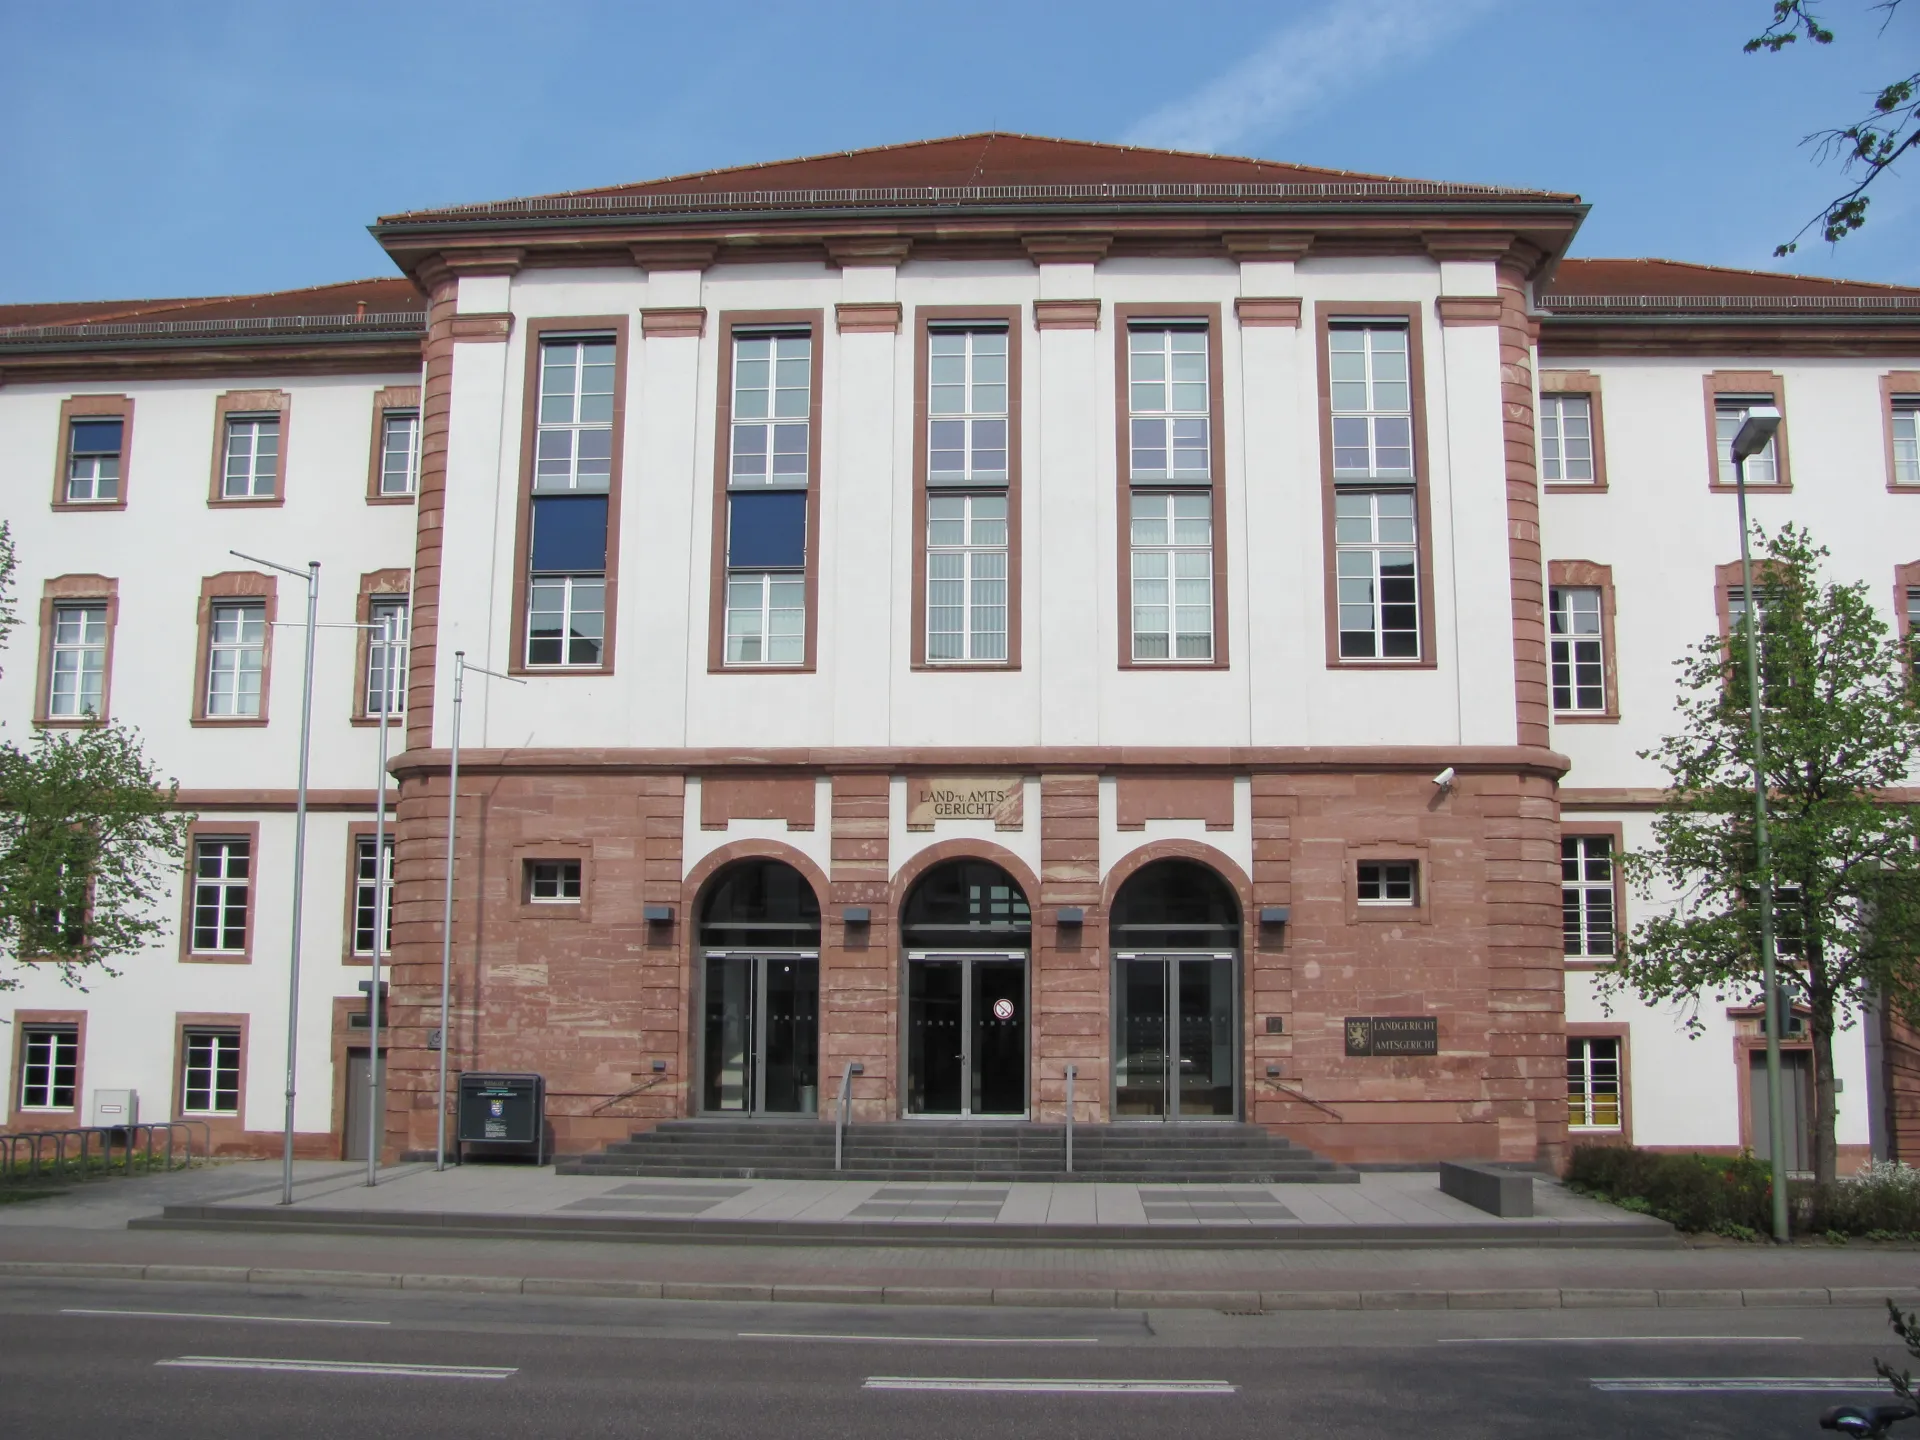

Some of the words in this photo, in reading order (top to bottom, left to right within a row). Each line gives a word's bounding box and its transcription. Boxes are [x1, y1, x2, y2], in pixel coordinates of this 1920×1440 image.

[934, 803, 995, 815] GERICHT
[1373, 1021, 1436, 1031] LANDGERICHT
[1375, 1040, 1436, 1050] AMTSGERICHT
